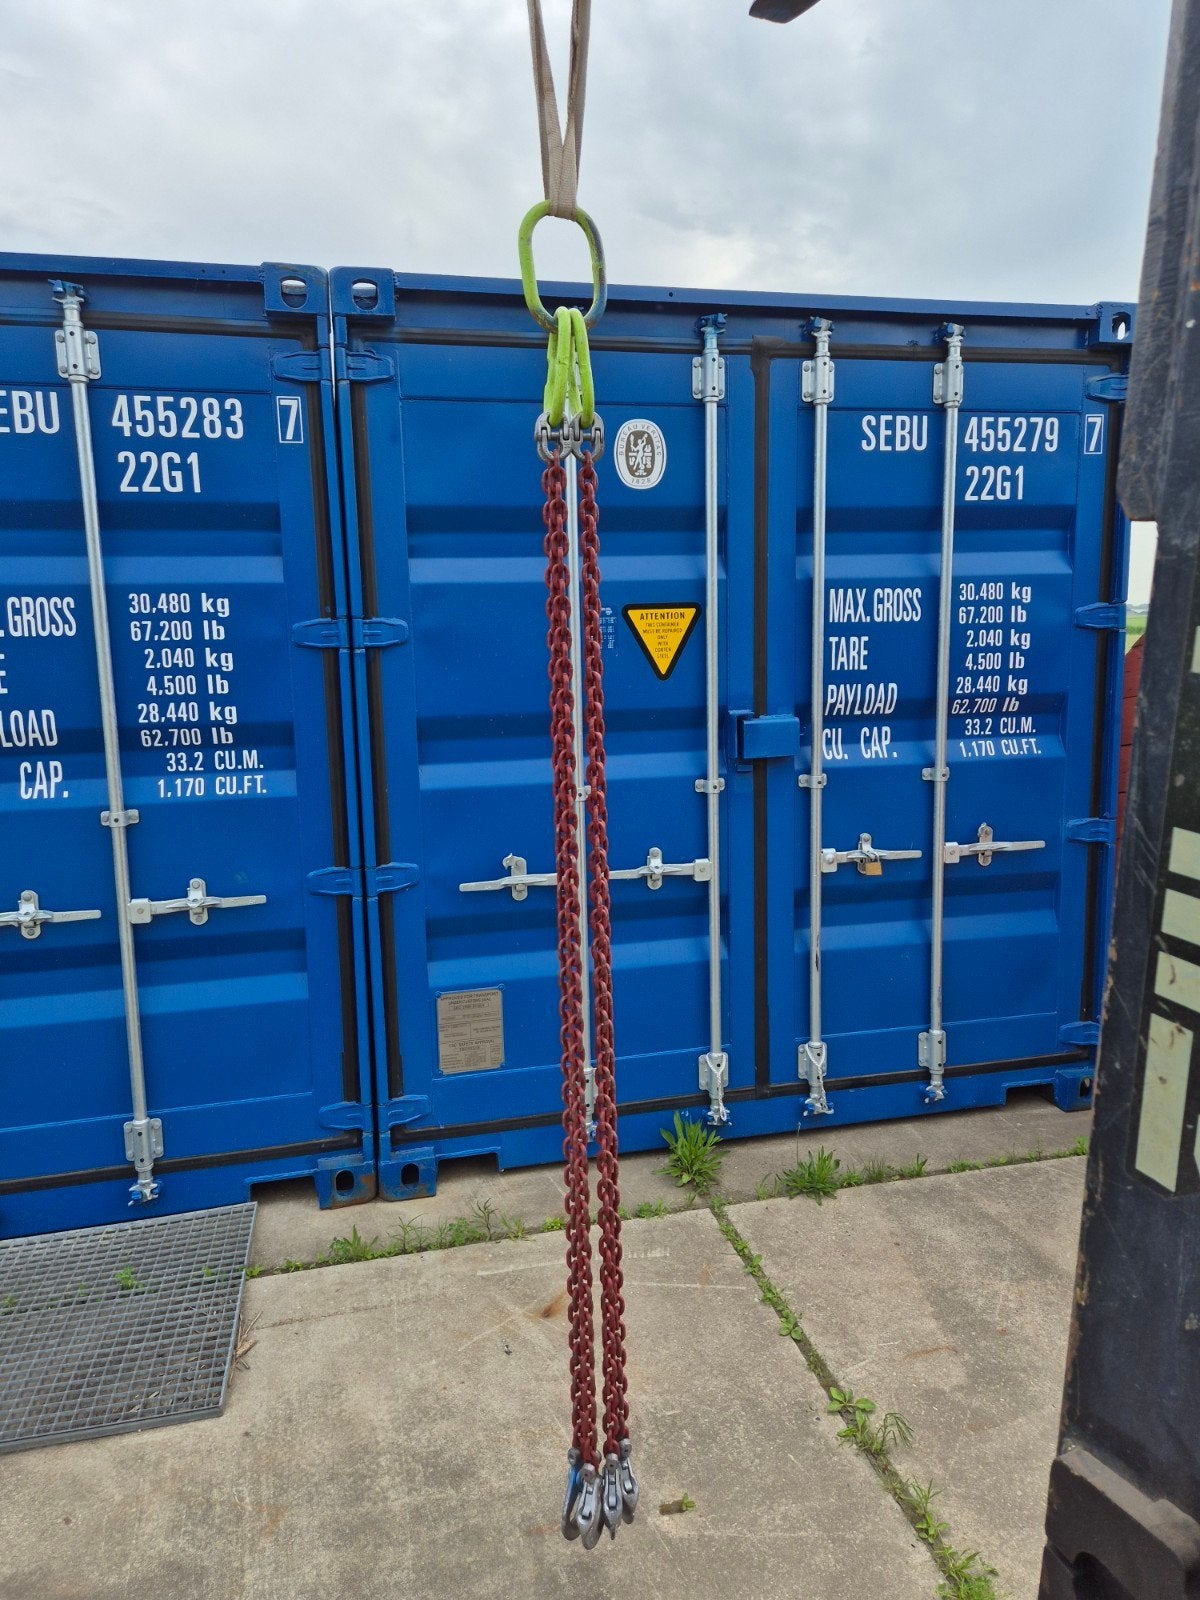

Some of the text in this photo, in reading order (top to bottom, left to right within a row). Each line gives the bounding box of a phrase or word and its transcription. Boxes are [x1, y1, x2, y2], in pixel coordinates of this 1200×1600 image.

[111, 394, 244, 440] 455283
[278, 399, 299, 440] 7
[619, 423, 662, 456] BUREAU VERITAS
[861, 415, 1101, 452] SEBU 455279 7
[117, 450, 201, 493] 22G1
[964, 465, 1024, 501] 22G1
[201, 592, 230, 617] kg
[1011, 582, 1032, 603] kg
[639, 612, 685, 620] ATTENTION
[1010, 605, 1027, 623] lb
[203, 620, 226, 641] lb
[205, 647, 234, 672] kg
[829, 636, 869, 671] TARE
[1009, 628, 1031, 650] kg
[1008, 652, 1025, 669] lb
[206, 674, 230, 695] lb
[825, 682, 898, 715] PAYLOAD
[1007, 675, 1028, 695] kg
[209, 701, 238, 725] kg
[1002, 697, 1020, 712] lb
[211, 727, 235, 745] lb
[822, 717, 1036, 760] CU. CAP. 33.2 CU.M.
[1001, 738, 1042, 756] CU.FT.
[19, 749, 265, 800] CAP. 33.2 CU.M.
[215, 774, 267, 795] CU.FT.
